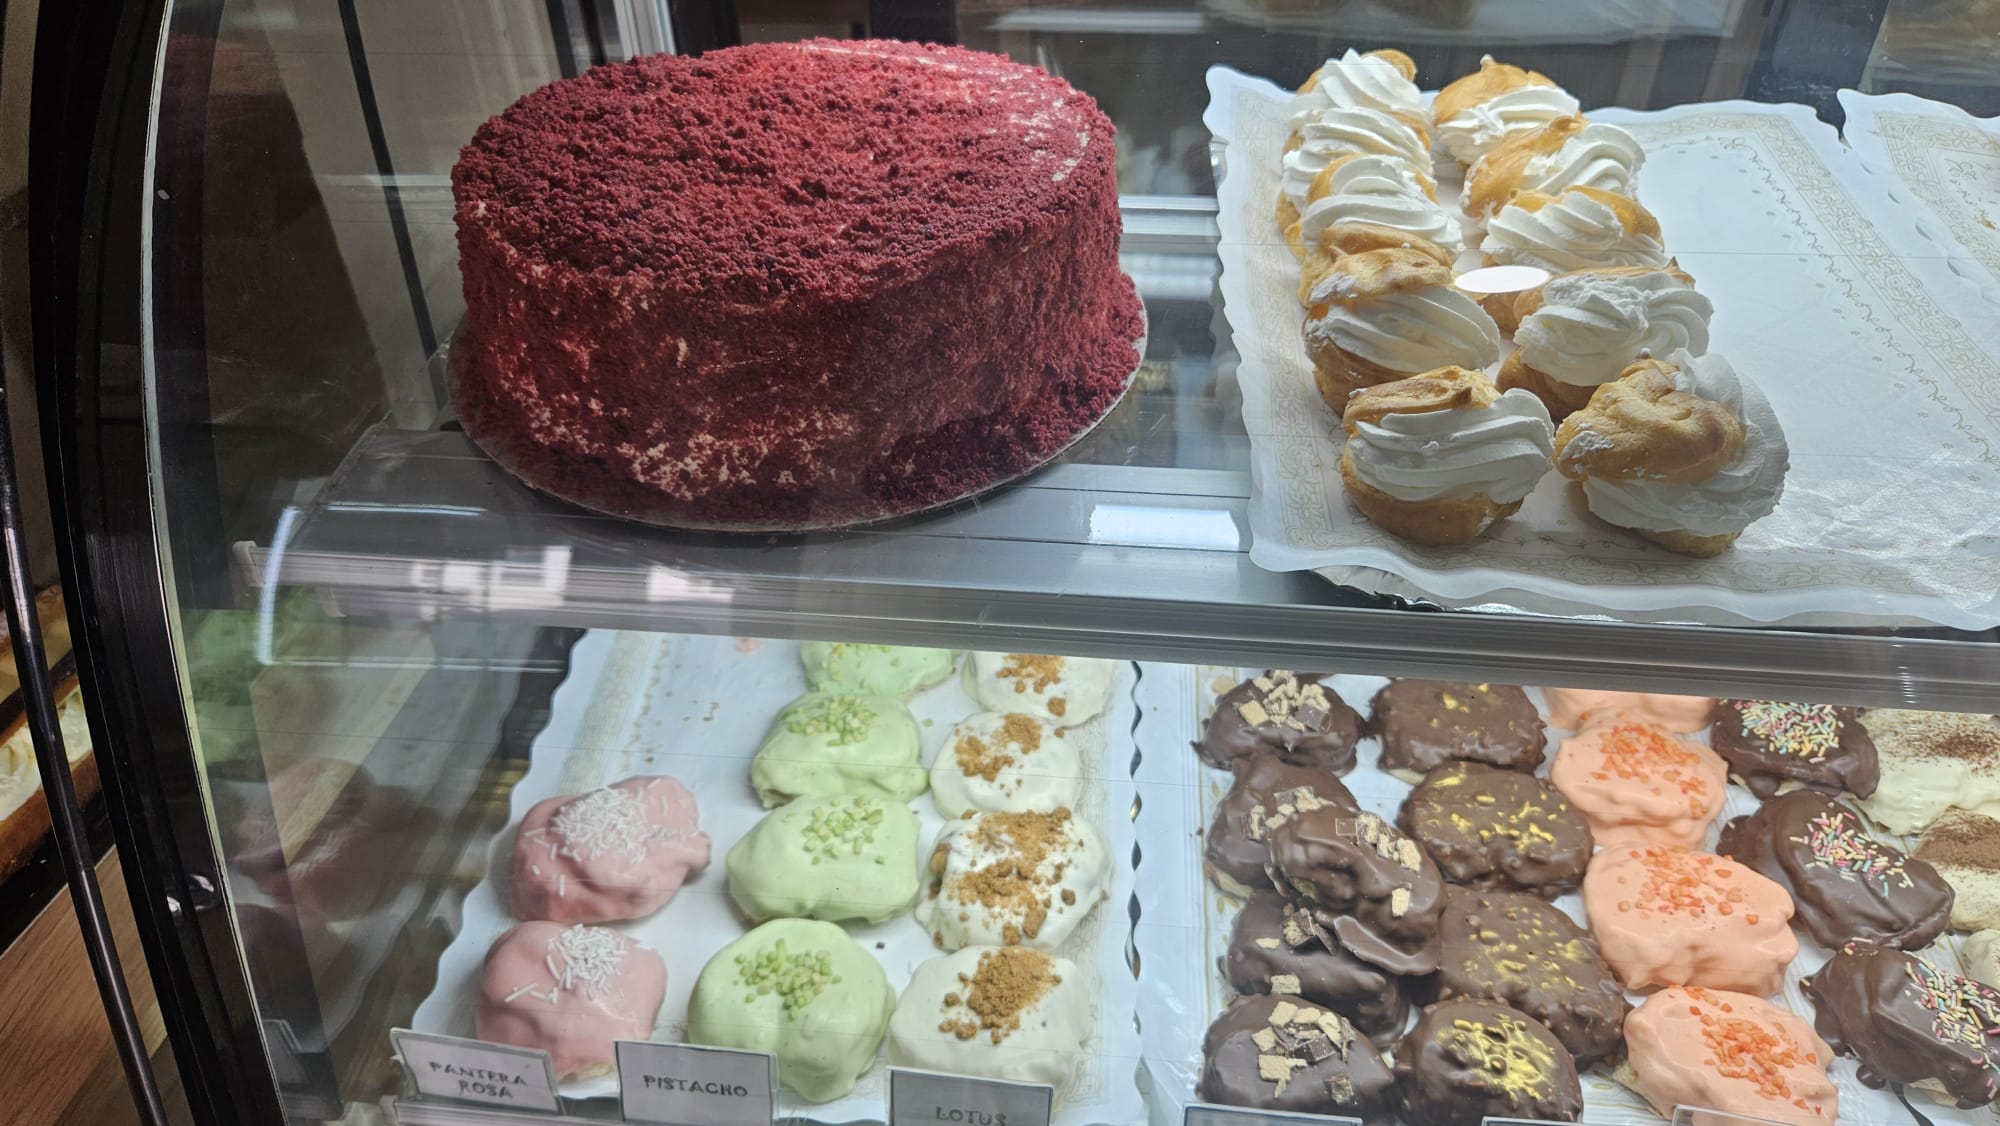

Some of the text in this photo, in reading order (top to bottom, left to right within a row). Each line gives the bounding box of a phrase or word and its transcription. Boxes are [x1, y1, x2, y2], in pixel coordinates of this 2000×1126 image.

[428, 1060, 528, 1087] PANTERA
[457, 1079, 513, 1099] ROSA
[642, 1074, 748, 1098] PISTACHO
[936, 1106, 1007, 1126] LOTUS
